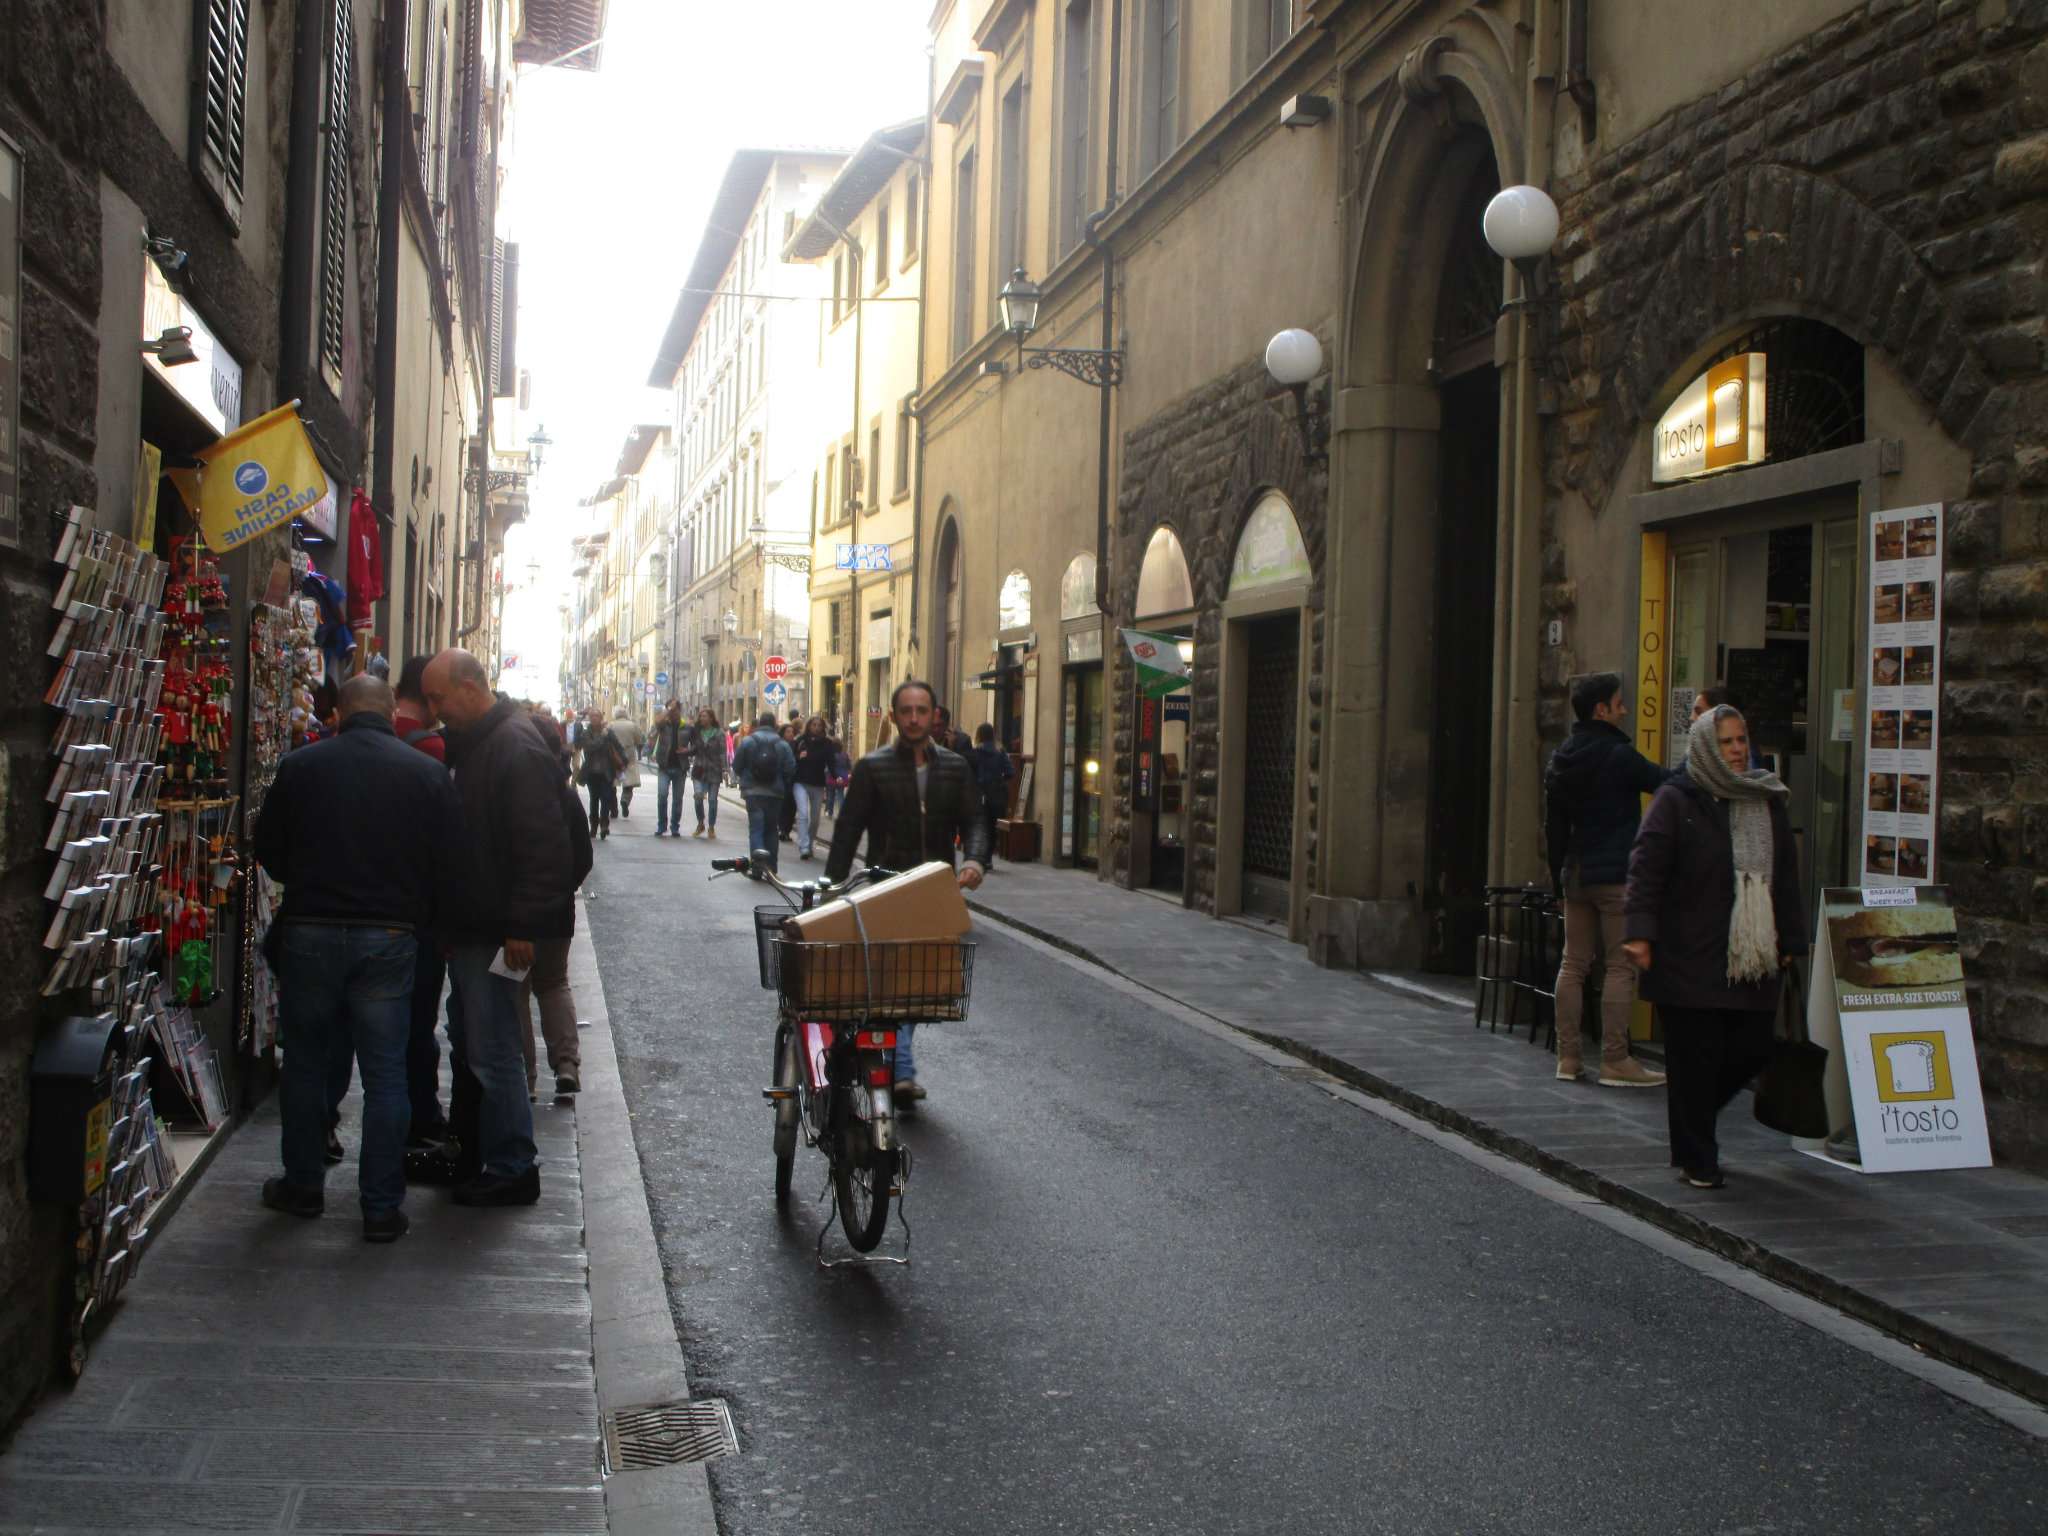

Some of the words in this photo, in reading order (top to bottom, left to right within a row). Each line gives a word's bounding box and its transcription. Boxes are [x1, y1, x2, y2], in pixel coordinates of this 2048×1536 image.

[838, 543, 893, 570] BAR
[765, 663, 787, 673] STOP
[1642, 598, 1661, 752] TOAST
[1165, 703, 1190, 711] ZEISS
[1843, 994, 1872, 1006] FRESH
[1873, 992, 1924, 1005] EXTRA-SIZE
[1924, 991, 1961, 1003] TOASTS!
[1880, 1104, 1959, 1133] i'tosto
